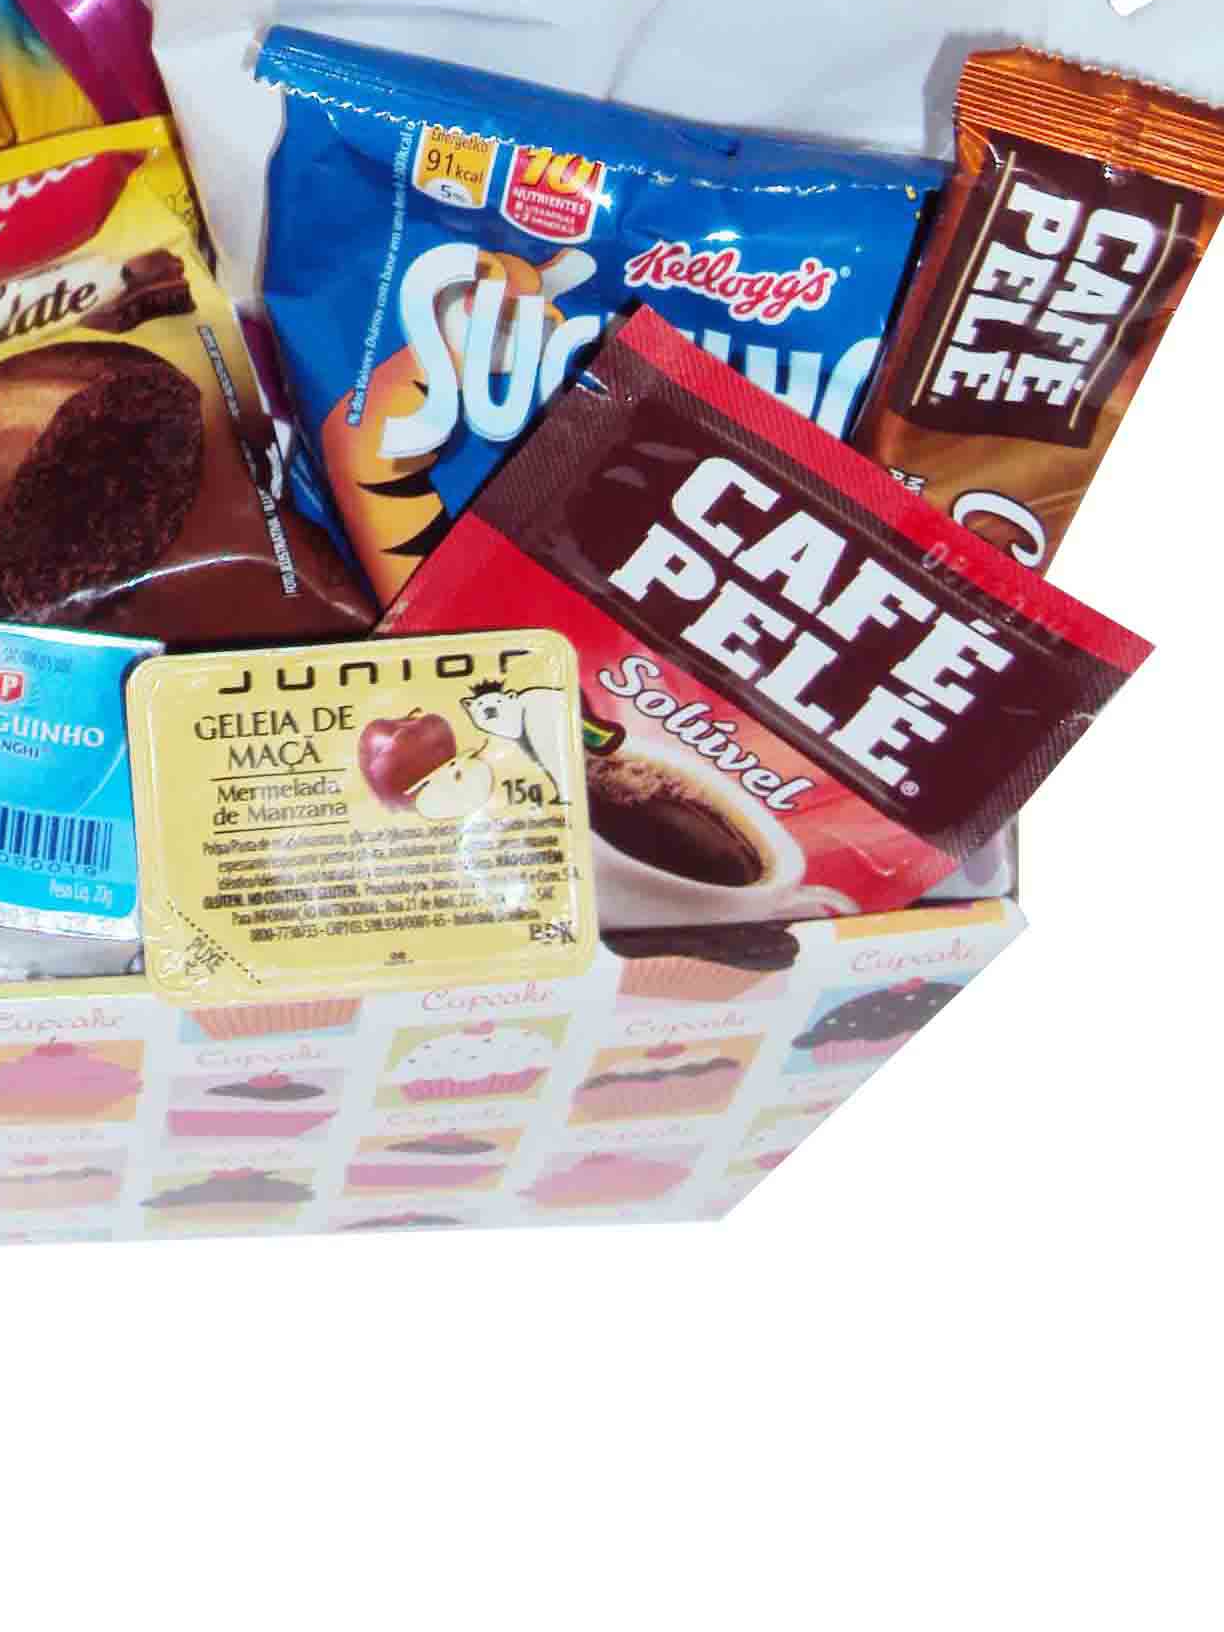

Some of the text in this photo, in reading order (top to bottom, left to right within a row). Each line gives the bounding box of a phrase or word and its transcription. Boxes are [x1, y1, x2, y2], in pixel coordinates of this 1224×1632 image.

[426, 149, 485, 185] 91 kcal
[627, 241, 831, 321] Kellogg's
[672, 455, 1015, 716] CAFÉ
[607, 521, 947, 788] PELÉ
[194, 704, 356, 742] GELEIA DE
[598, 655, 816, 812] Solúvel
[227, 735, 321, 772] MAÇÃ
[216, 775, 343, 806] Mermelada
[501, 776, 544, 809] 15g
[212, 799, 349, 827] de Manzana
